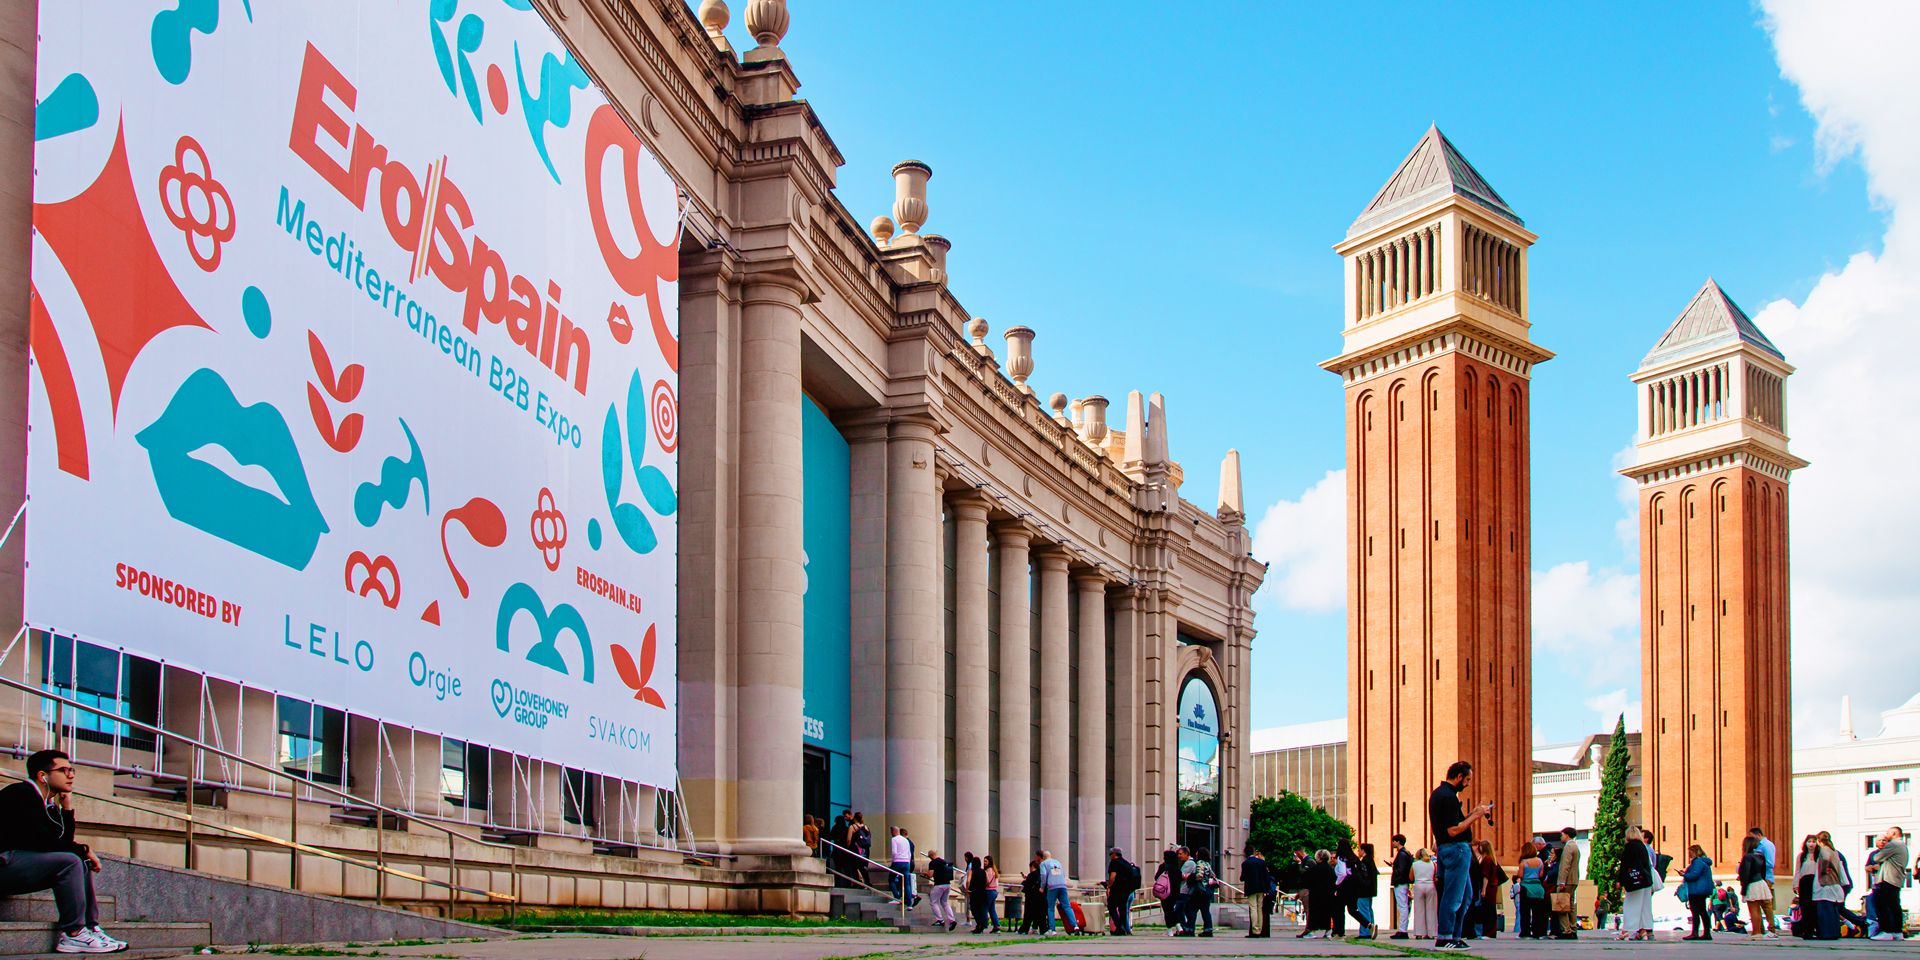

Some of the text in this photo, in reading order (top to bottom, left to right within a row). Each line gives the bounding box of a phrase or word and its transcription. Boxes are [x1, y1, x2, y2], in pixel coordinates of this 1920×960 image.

[276, 185, 581, 448] Mediterranean B2B Expo
[116, 562, 242, 626] SPONSORED BY
[577, 565, 642, 614] EROSPAIN.EU
[285, 614, 374, 671] LELO
[409, 651, 461, 701] Orgie
[514, 707, 548, 730] GROUP
[515, 688, 569, 719] LOVEHONEY
[589, 716, 650, 753] SVAKOM
